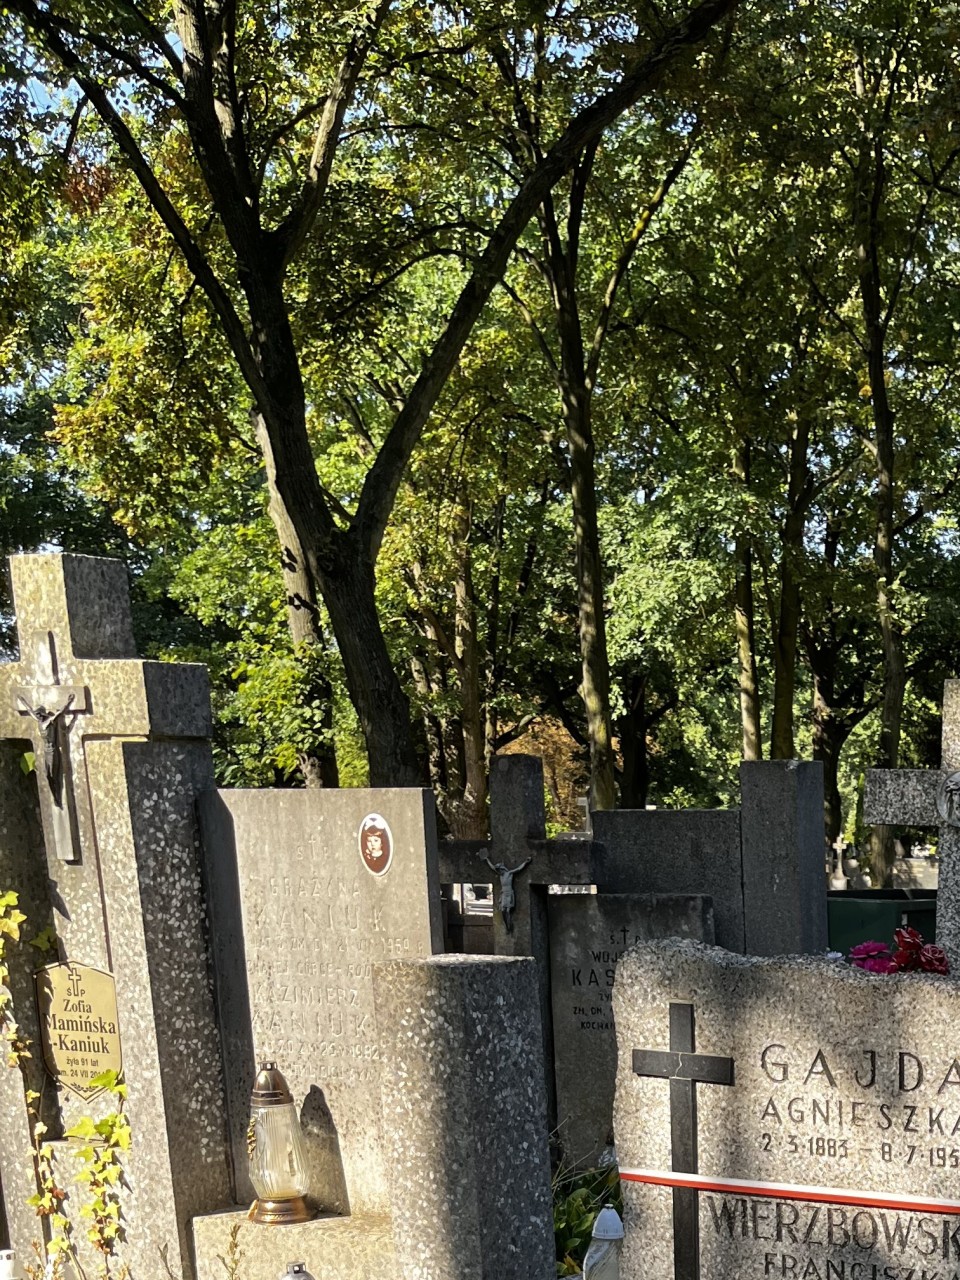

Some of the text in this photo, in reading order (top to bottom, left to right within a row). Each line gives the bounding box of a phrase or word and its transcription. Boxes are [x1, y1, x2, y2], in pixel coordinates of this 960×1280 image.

[63, 998, 92, 1014] Zofia
[53, 1033, 110, 1054] -Kaniuk
[66, 1057, 99, 1067] żyła 91 lat
[71, 1069, 79, 1077] 24
